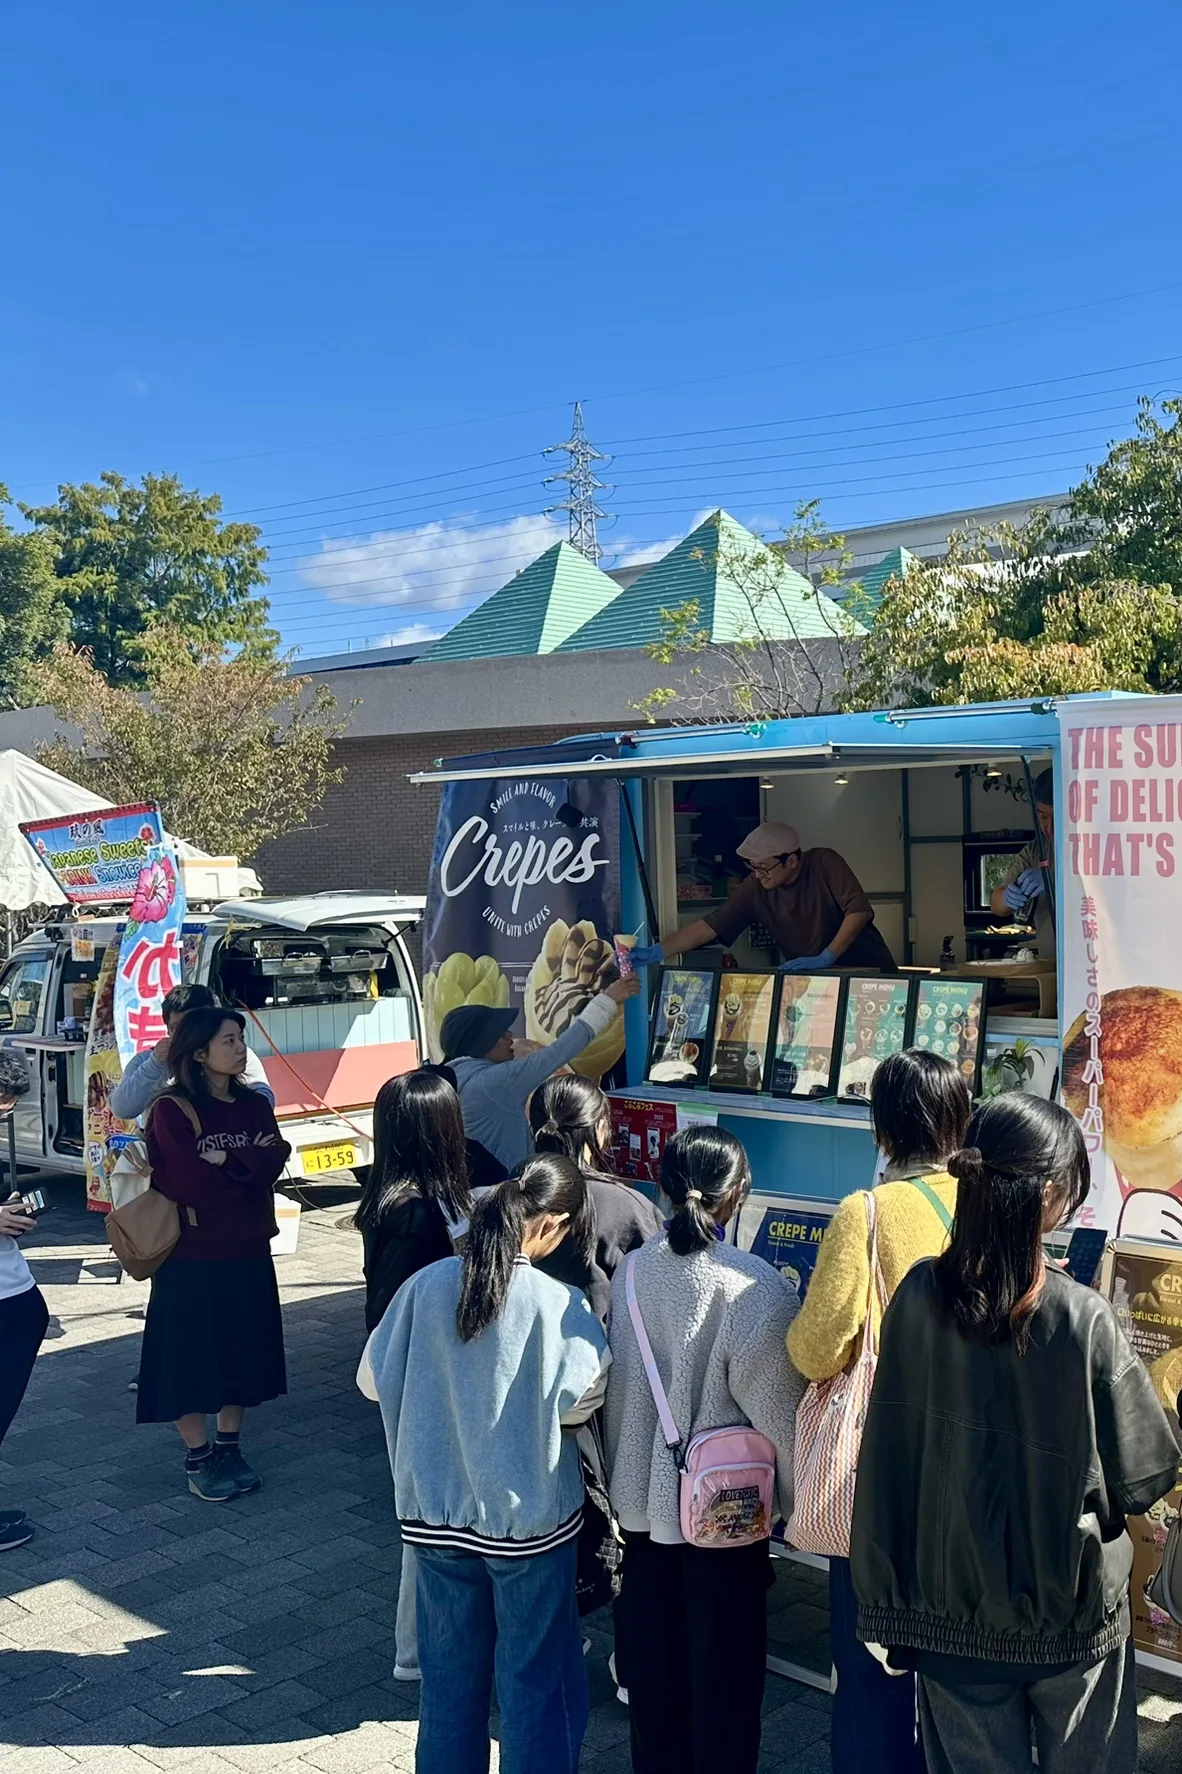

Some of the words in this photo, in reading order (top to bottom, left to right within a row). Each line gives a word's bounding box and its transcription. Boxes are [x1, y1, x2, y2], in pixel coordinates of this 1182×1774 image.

[1068, 726, 1124, 770] THE
[490, 787, 513, 814] SMILE
[514, 782, 529, 796] AND
[530, 782, 557, 808] FLAVOR
[1069, 780, 1099, 823] OF
[99, 837, 148, 861] Sweets
[441, 815, 610, 914] Crepes
[1069, 833, 1175, 877] THAT'S
[482, 906, 505, 932] UNITE
[506, 923, 522, 937] WITH
[524, 905, 551, 935] CREPES
[861, 983, 878, 991] CREPE
[878, 984, 896, 992] MENU
[932, 986, 949, 994] CREPE
[949, 987, 968, 995] MENU
[317, 1150, 354, 1169] 13-59
[769, 1221, 807, 1240] CREPE
[810, 1226, 828, 1242] M
